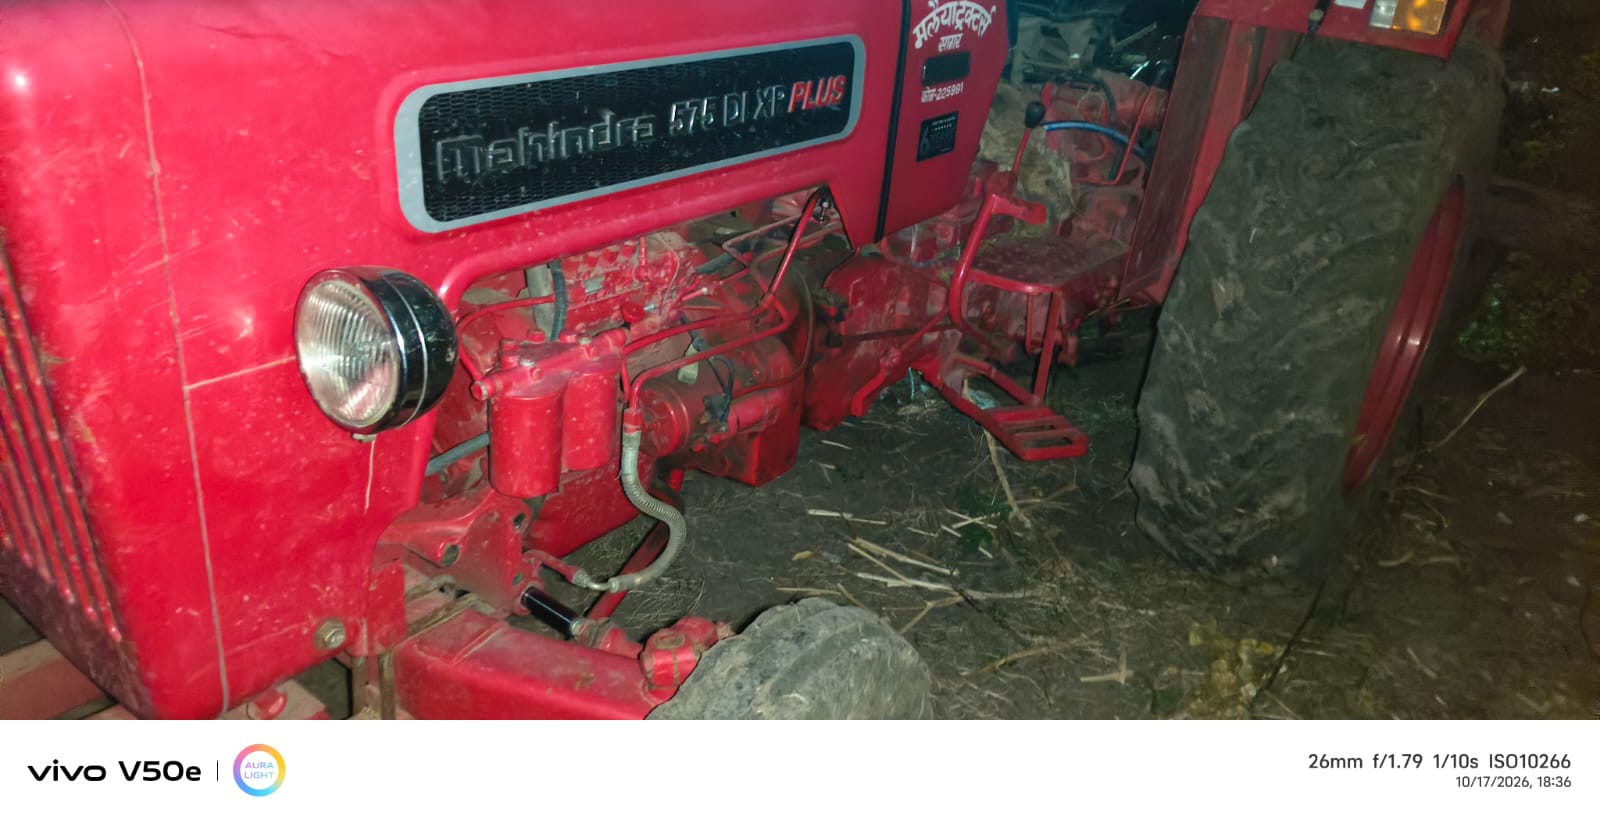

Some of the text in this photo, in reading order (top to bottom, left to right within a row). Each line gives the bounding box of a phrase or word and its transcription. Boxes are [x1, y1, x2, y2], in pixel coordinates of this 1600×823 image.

[436, 74, 848, 183] Mahindra 575 DI XP PLUS
